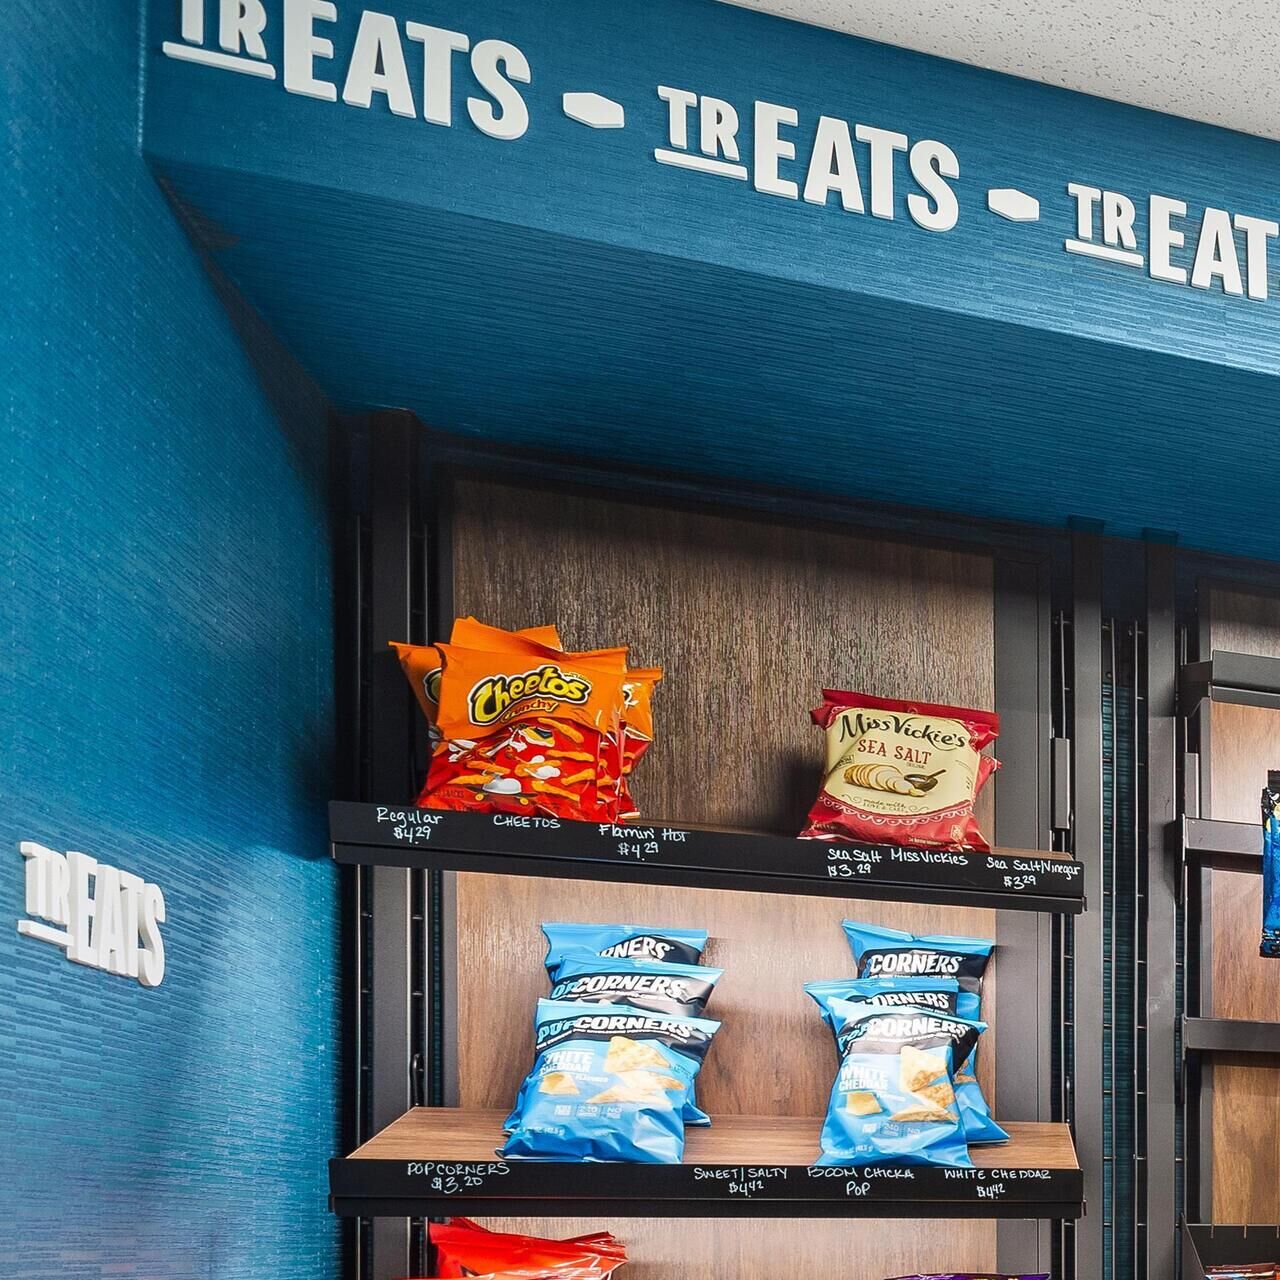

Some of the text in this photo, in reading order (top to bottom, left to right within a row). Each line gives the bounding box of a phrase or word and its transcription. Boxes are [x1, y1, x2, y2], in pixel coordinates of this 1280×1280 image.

[163, 0, 532, 140] TREATS
[654, 85, 960, 232] TREATS
[468, 665, 592, 725] Cheetos
[840, 713, 965, 751] Miss Vickie's
[858, 740, 932, 765] SEA SALT
[376, 807, 443, 828] Regular
[493, 816, 561, 829] CHEETOS
[393, 826, 432, 844] $4.29
[617, 841, 660, 861] $4.29
[828, 848, 851, 862] Sea
[850, 848, 883, 863] Salt
[986, 857, 1008, 870] Sea
[828, 864, 871, 878] $3.29
[18, 841, 166, 987] TREATS
[537, 1016, 694, 1044] POPCORNERS
[807, 1166, 858, 1179] BOOM
[864, 1167, 915, 1180] CHICKA
[944, 1169, 988, 1181] WHITE
[991, 1170, 1052, 1181] CHEDDAR
[431, 1176, 483, 1194] $3.20
[728, 1180, 764, 1198] $4.42
